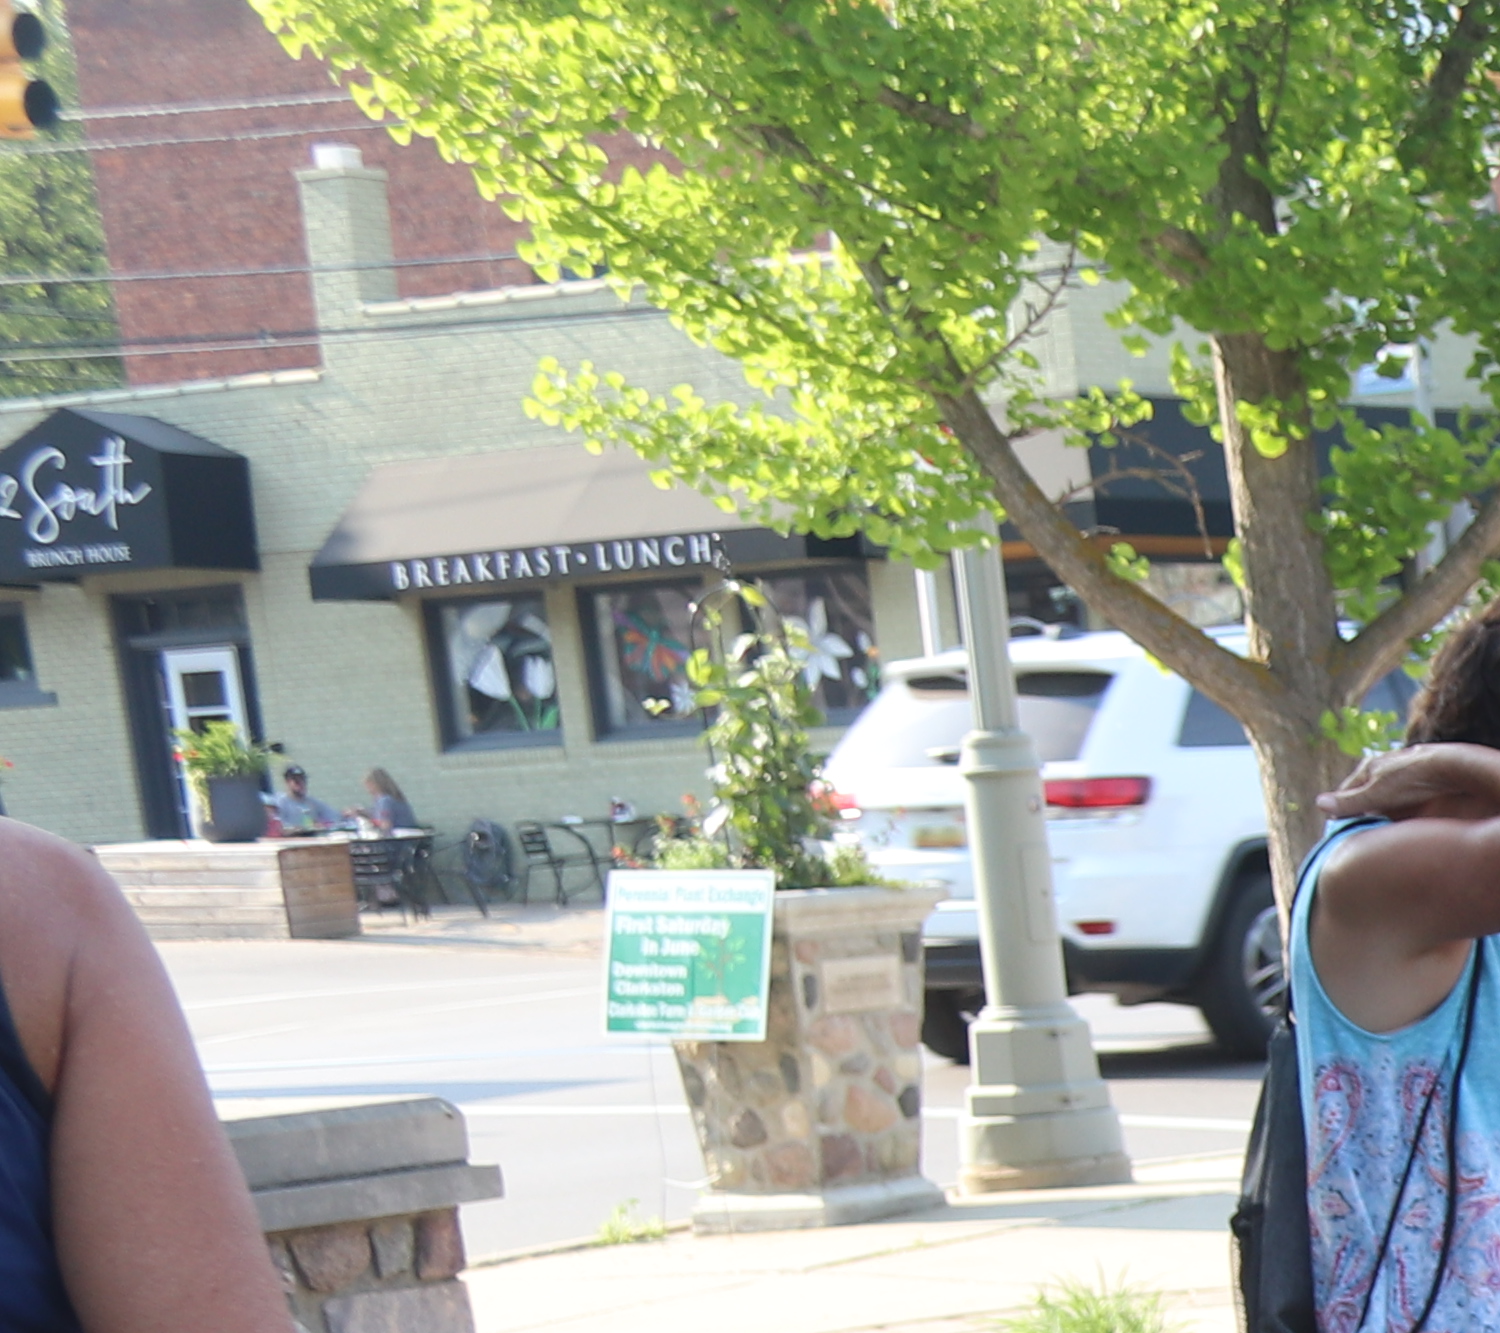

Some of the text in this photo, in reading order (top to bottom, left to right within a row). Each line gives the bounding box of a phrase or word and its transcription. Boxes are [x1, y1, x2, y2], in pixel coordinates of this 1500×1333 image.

[21, 434, 153, 544] South
[24, 542, 133, 568] BRUNCH HOUSE
[389, 533, 712, 591] BREAKFAST LUNCH
[655, 914, 731, 939] Saturday
[660, 937, 699, 957] June
[611, 961, 688, 979] Downtown
